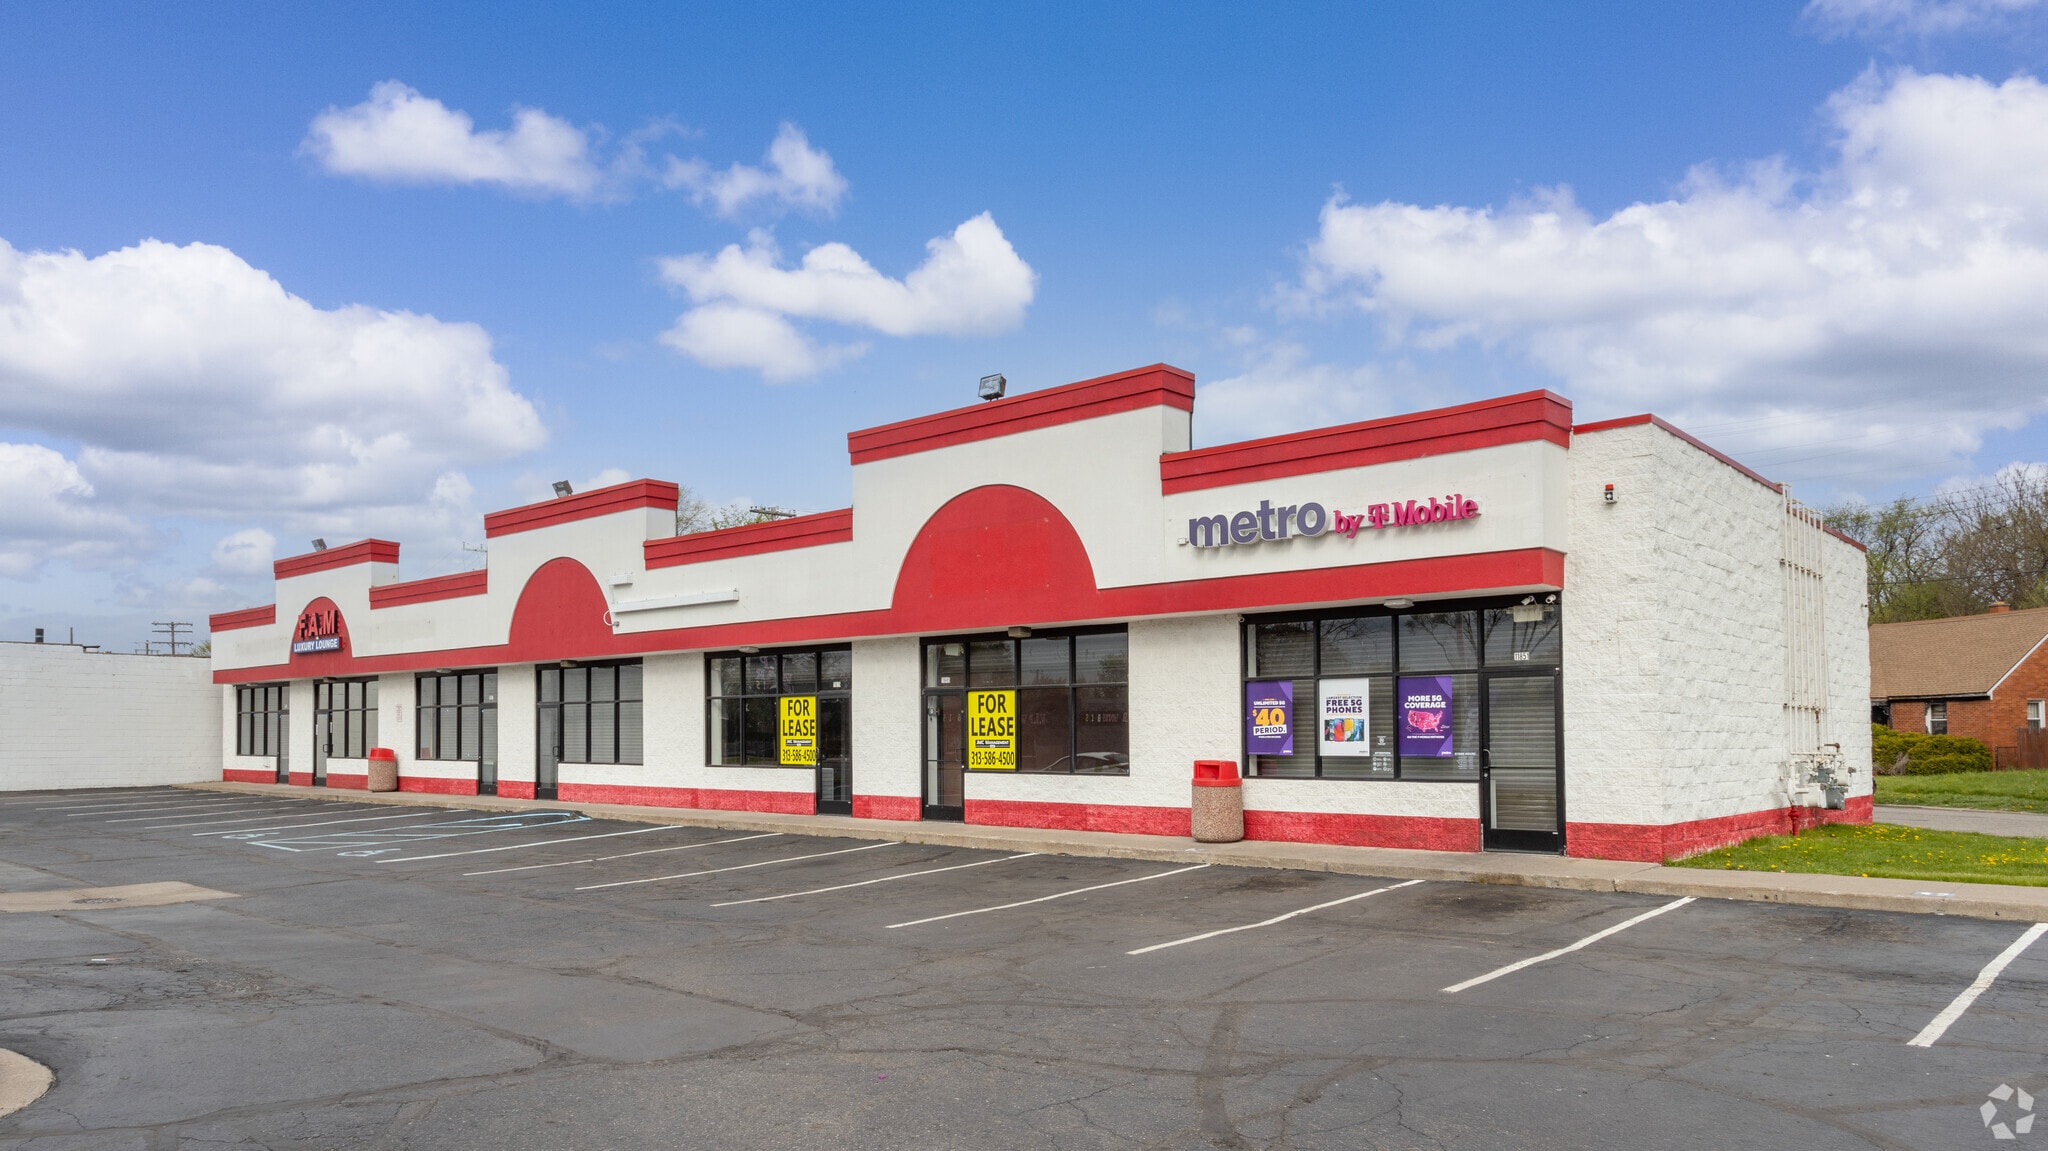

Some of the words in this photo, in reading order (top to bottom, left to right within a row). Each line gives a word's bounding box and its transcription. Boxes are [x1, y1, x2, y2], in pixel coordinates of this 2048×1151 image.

[1188, 500, 1327, 547] metro
[1333, 510, 1364, 538] by
[1391, 494, 1478, 527] Mobile
[294, 641, 315, 652] LUXURY
[315, 638, 338, 650] LOUNGE
[787, 699, 811, 717] FOR
[977, 693, 1007, 714] FOR
[1326, 706, 1363, 714] PHONES
[971, 716, 1015, 737] LEASE
[1252, 708, 1286, 727] $40
[782, 719, 816, 737] LEASE
[1255, 727, 1286, 735] PERIOD.
[782, 748, 817, 762] 313-586-4500
[971, 751, 1015, 766] 313-586-4500
